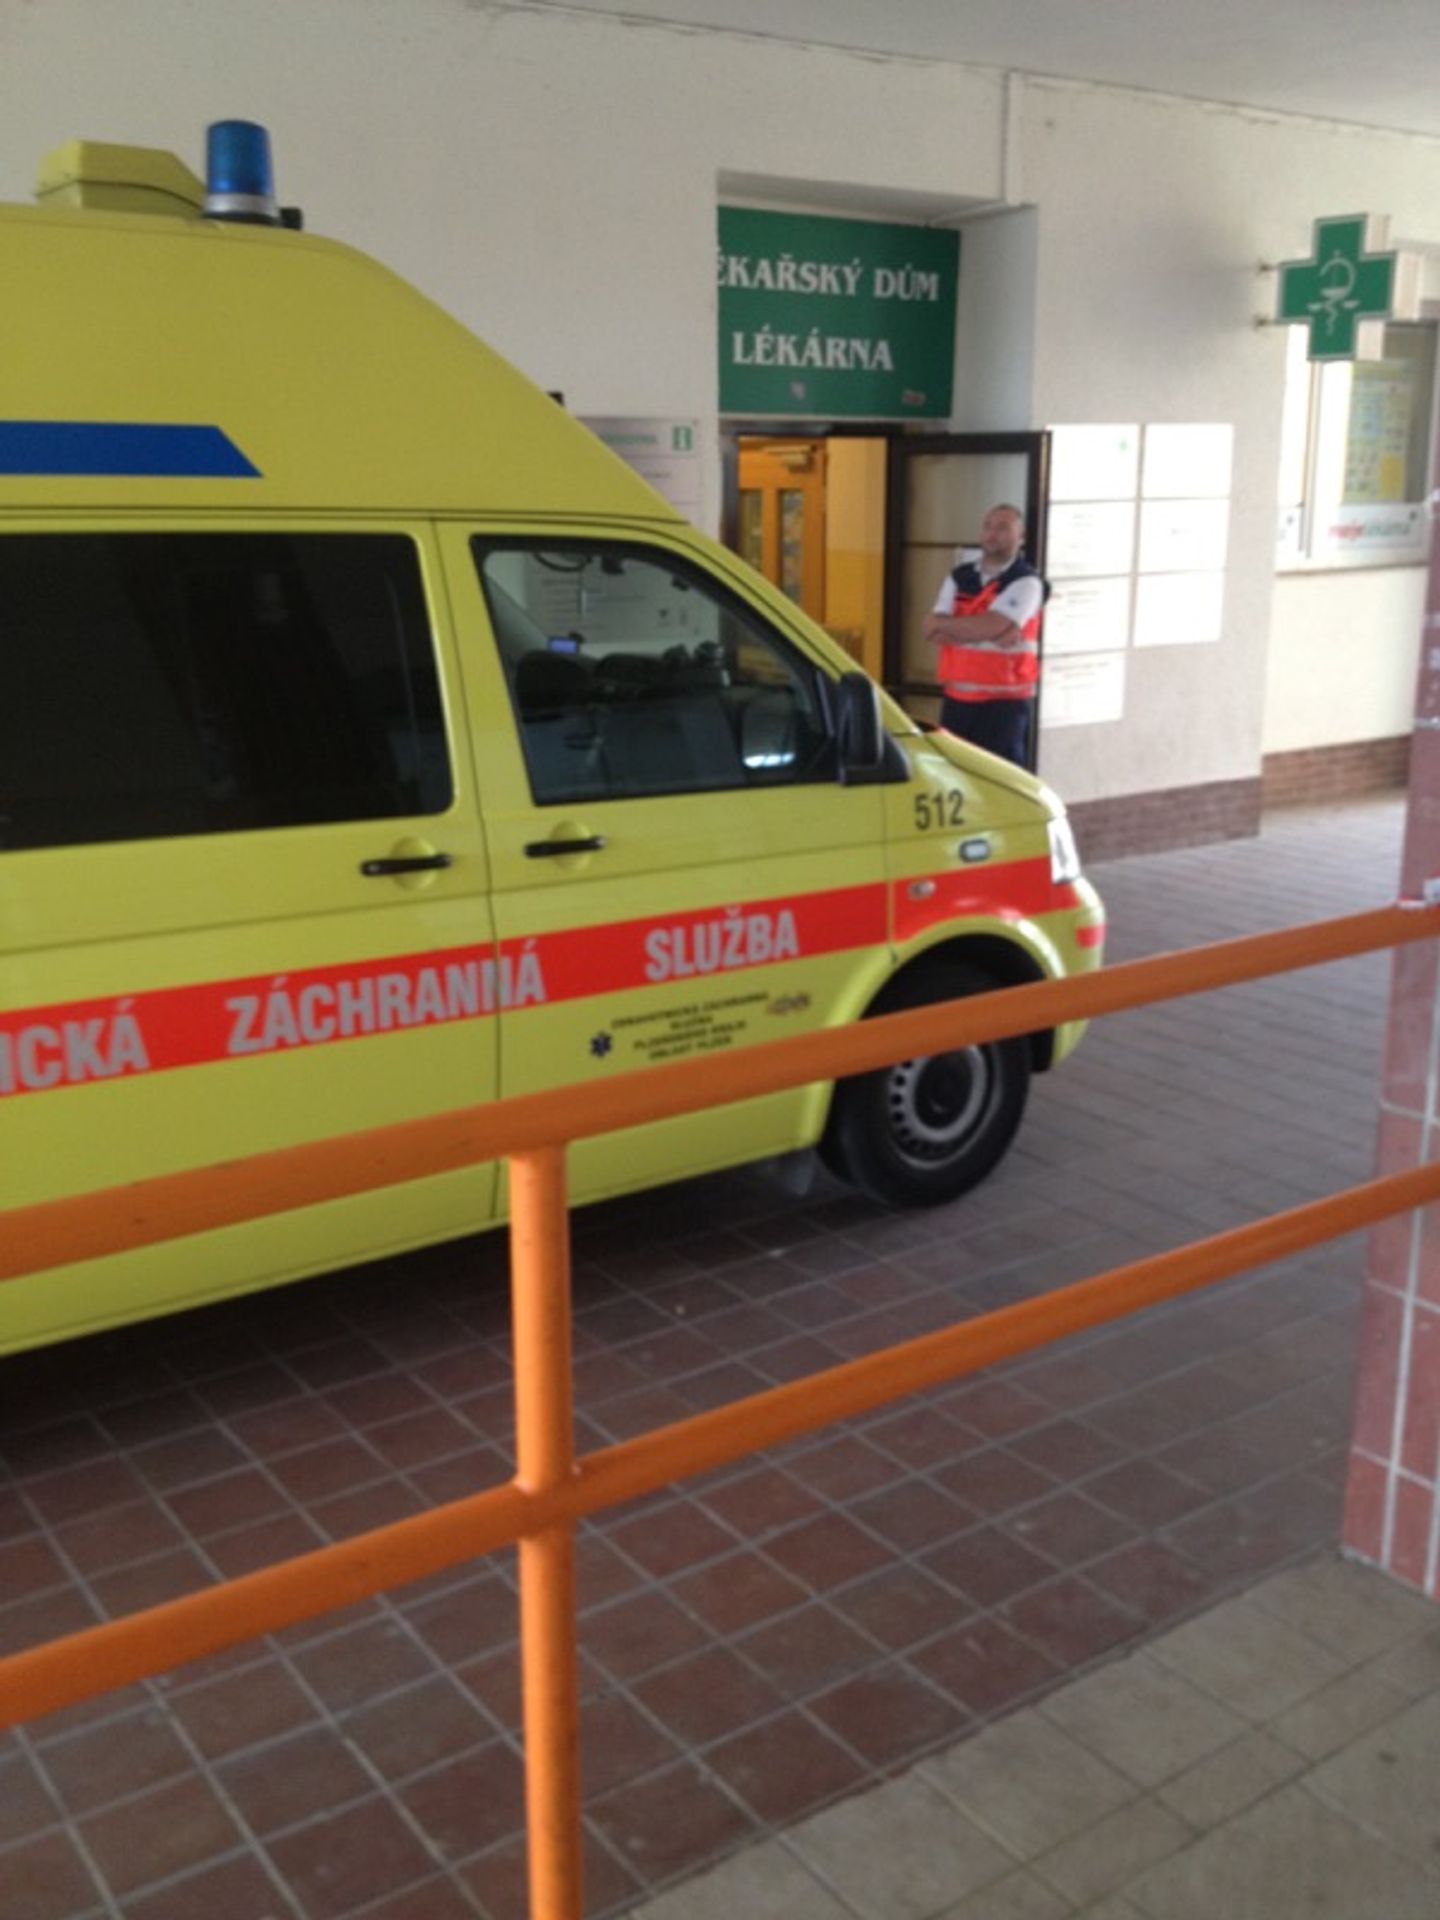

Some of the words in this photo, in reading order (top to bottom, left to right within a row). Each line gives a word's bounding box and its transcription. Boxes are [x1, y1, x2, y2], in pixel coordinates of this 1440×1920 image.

[732, 323, 894, 371] LÉKÁRNA
[914, 789, 965, 831] 512
[225, 938, 546, 1055] ZÁCHRANNÁ
[644, 905, 799, 981] SLUŽBA
